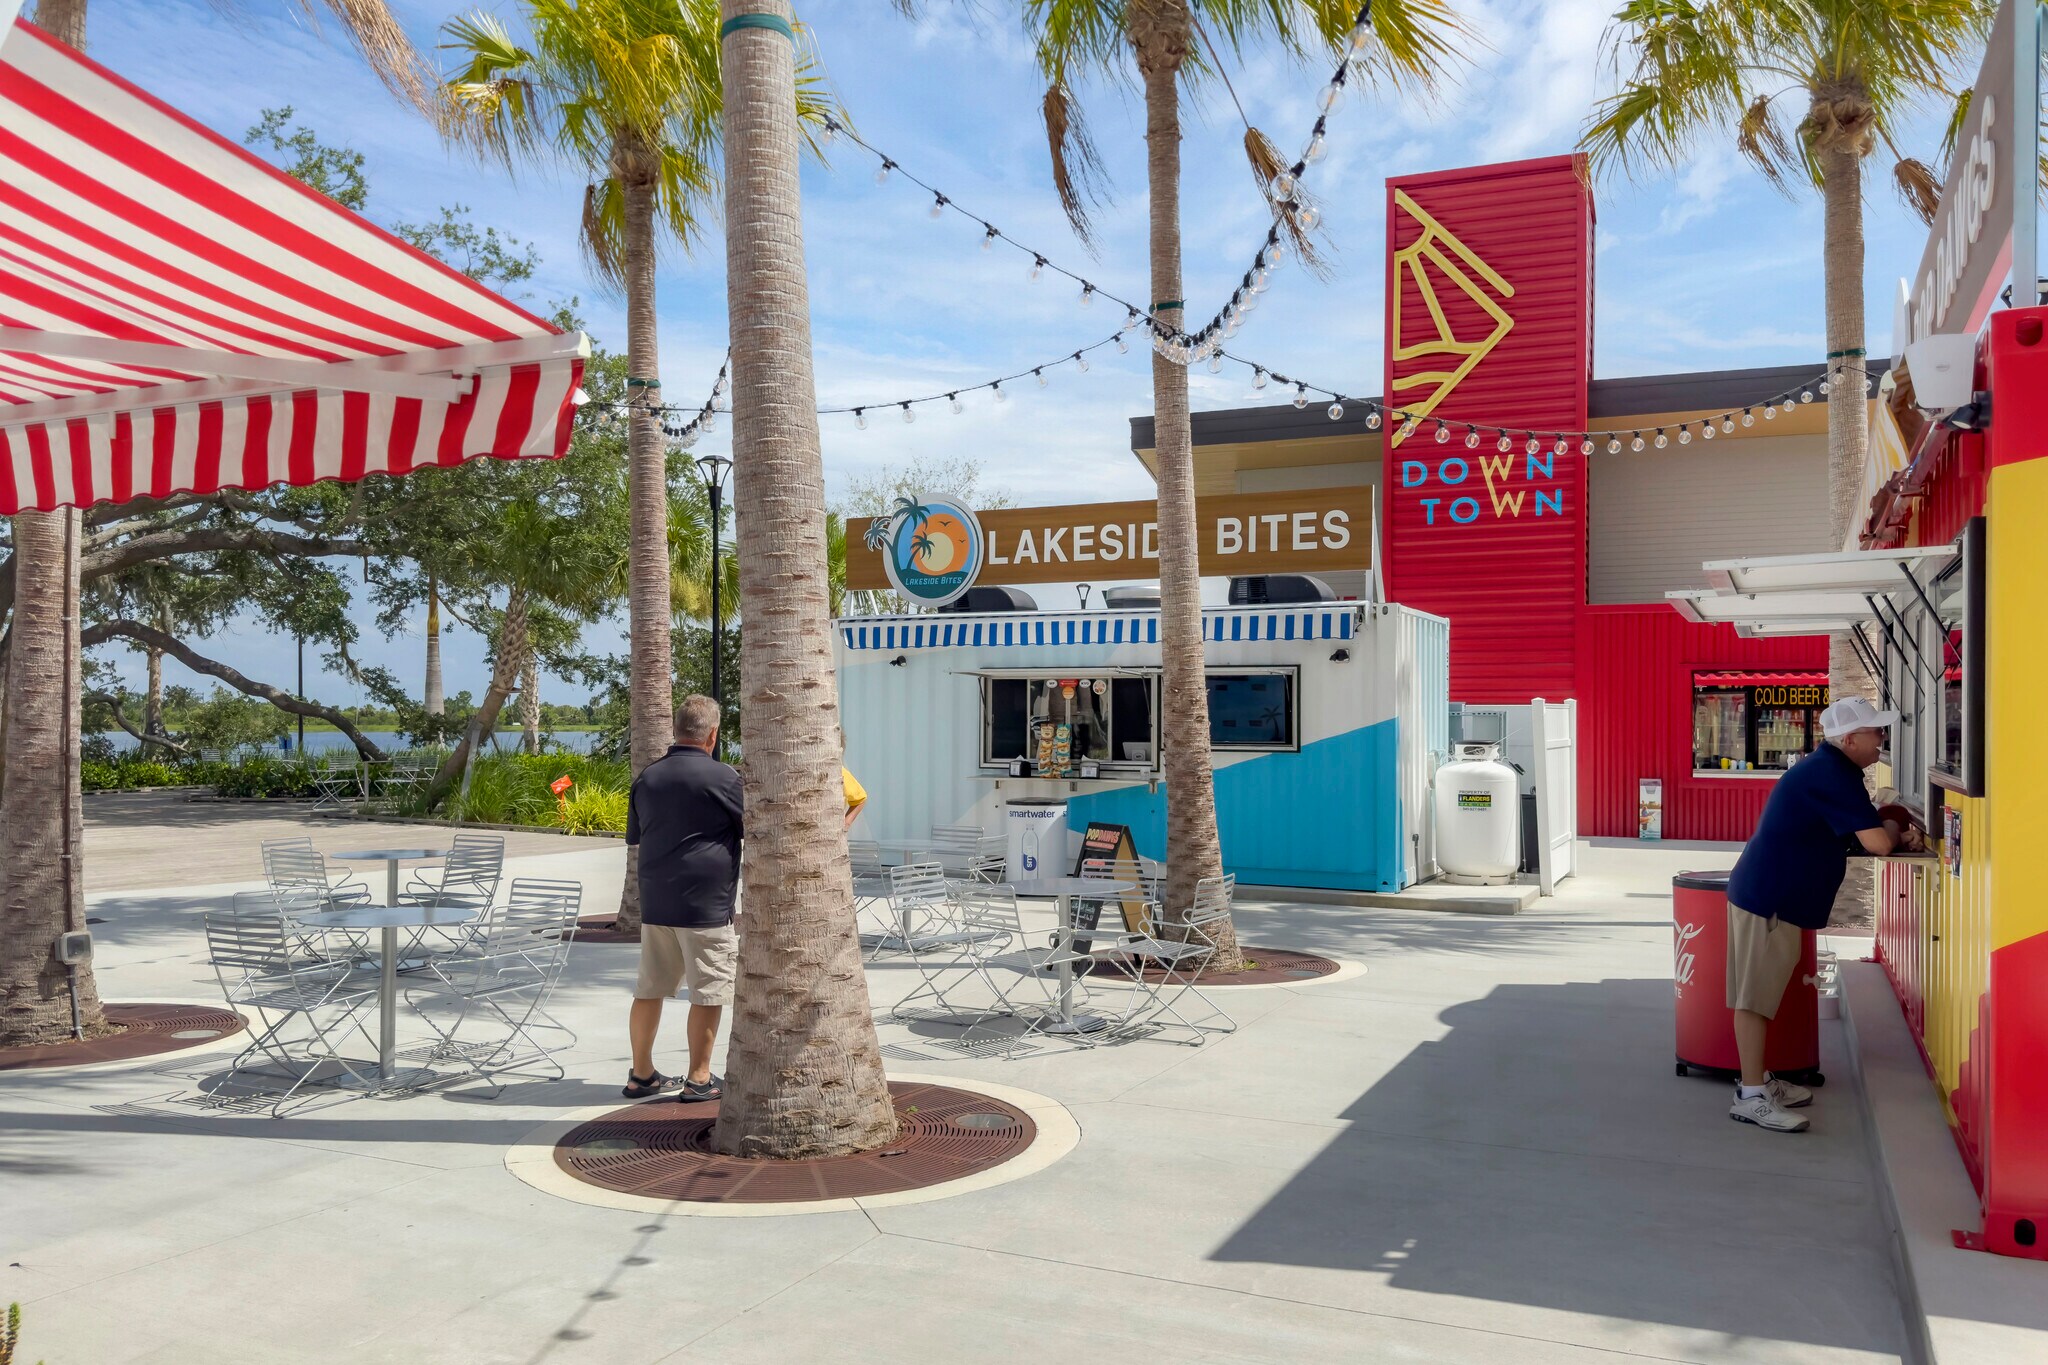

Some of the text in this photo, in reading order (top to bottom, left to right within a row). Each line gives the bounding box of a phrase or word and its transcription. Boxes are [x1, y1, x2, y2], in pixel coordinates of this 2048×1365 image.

[1937, 95, 1996, 328] DAWGS
[1402, 451, 1553, 488] DOWN
[1419, 488, 1562, 525] TOWN
[988, 509, 1351, 565] LAKESID BITES
[905, 576, 963, 586] LAKESIDE BITES
[1754, 687, 1830, 705] COLD BEER &
[1009, 810, 1056, 818] smartwater
